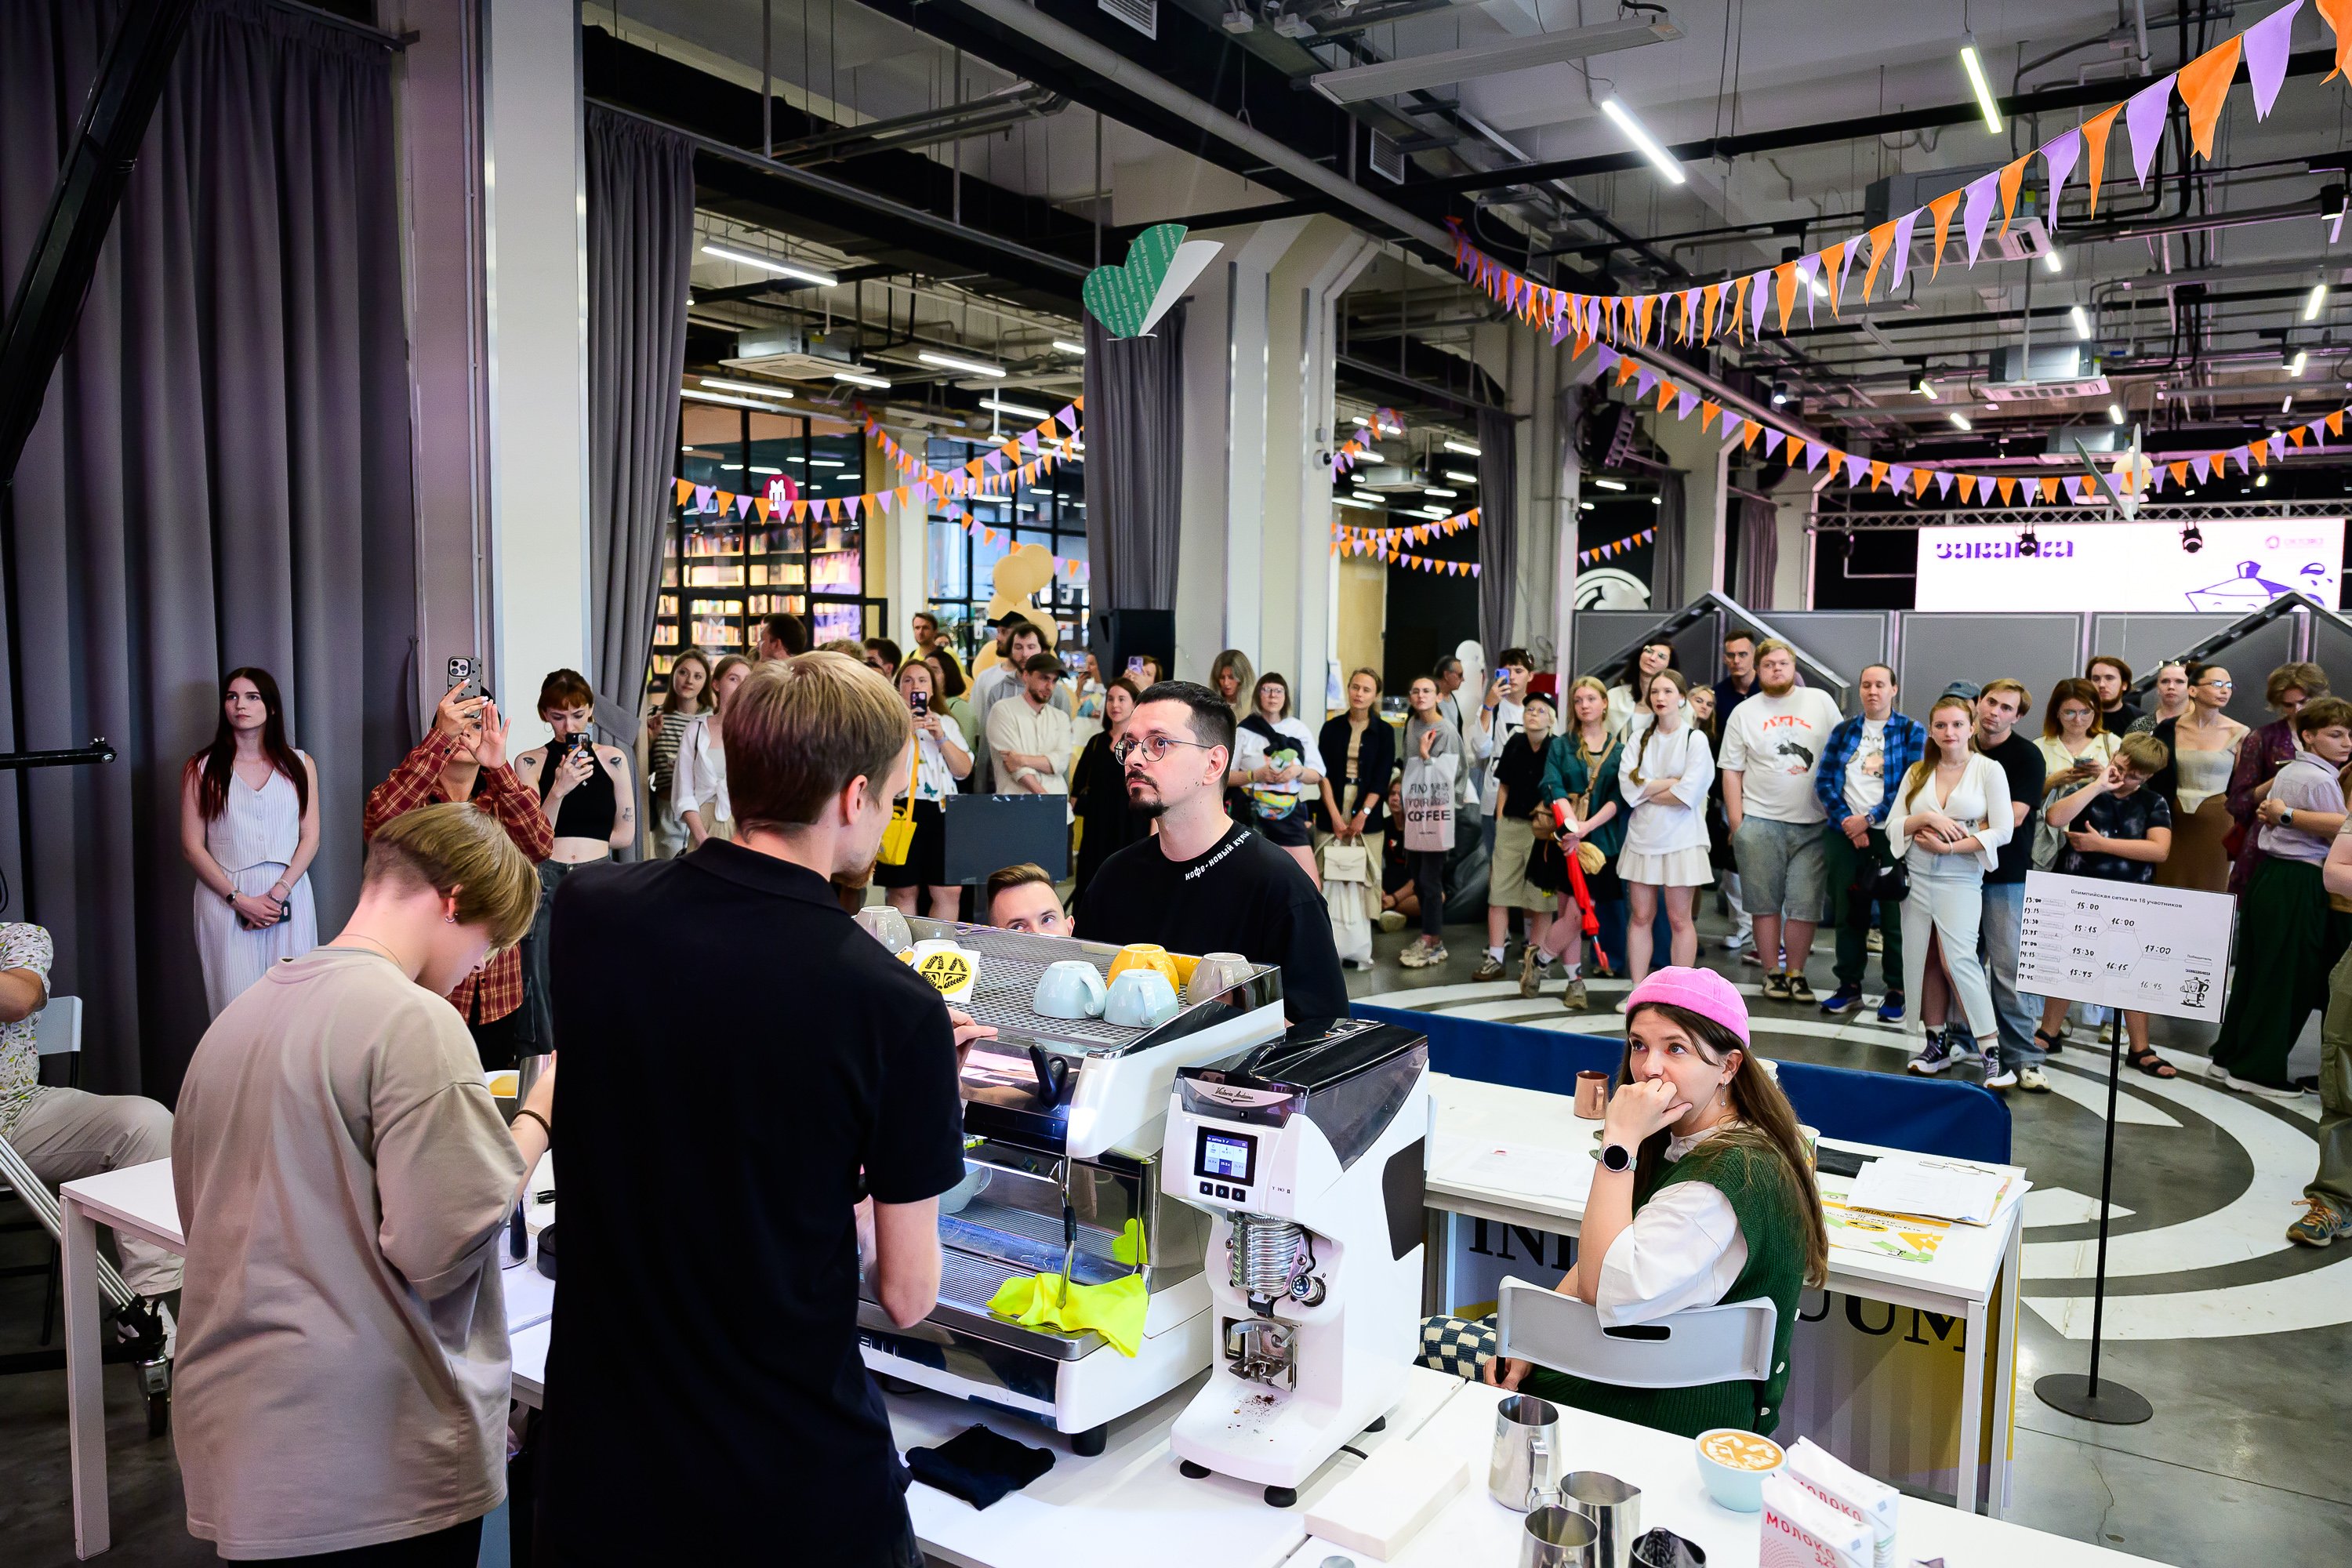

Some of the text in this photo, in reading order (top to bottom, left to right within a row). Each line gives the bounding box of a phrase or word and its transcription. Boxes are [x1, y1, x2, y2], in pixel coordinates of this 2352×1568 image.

[1407, 810, 1450, 822] COFFEE
[1208, 844, 1234, 867] новый
[2071, 889, 2111, 899] Олимпийская
[2077, 902, 2100, 910] 15:00
[2111, 917, 2135, 927] 16:00
[2074, 924, 2097, 933] 15:15
[2072, 947, 2095, 956] 15:30
[2145, 945, 2171, 955] 17:00
[2106, 962, 2129, 971] 16:15
[2070, 969, 2092, 978] 15:45
[2140, 981, 2162, 990] 16:45
[1856, 1207, 1896, 1218] ДИПЛОМ
[1793, 1477, 1862, 1521] ОЛОКО
[1766, 1511, 1835, 1561] МОЛОКО
